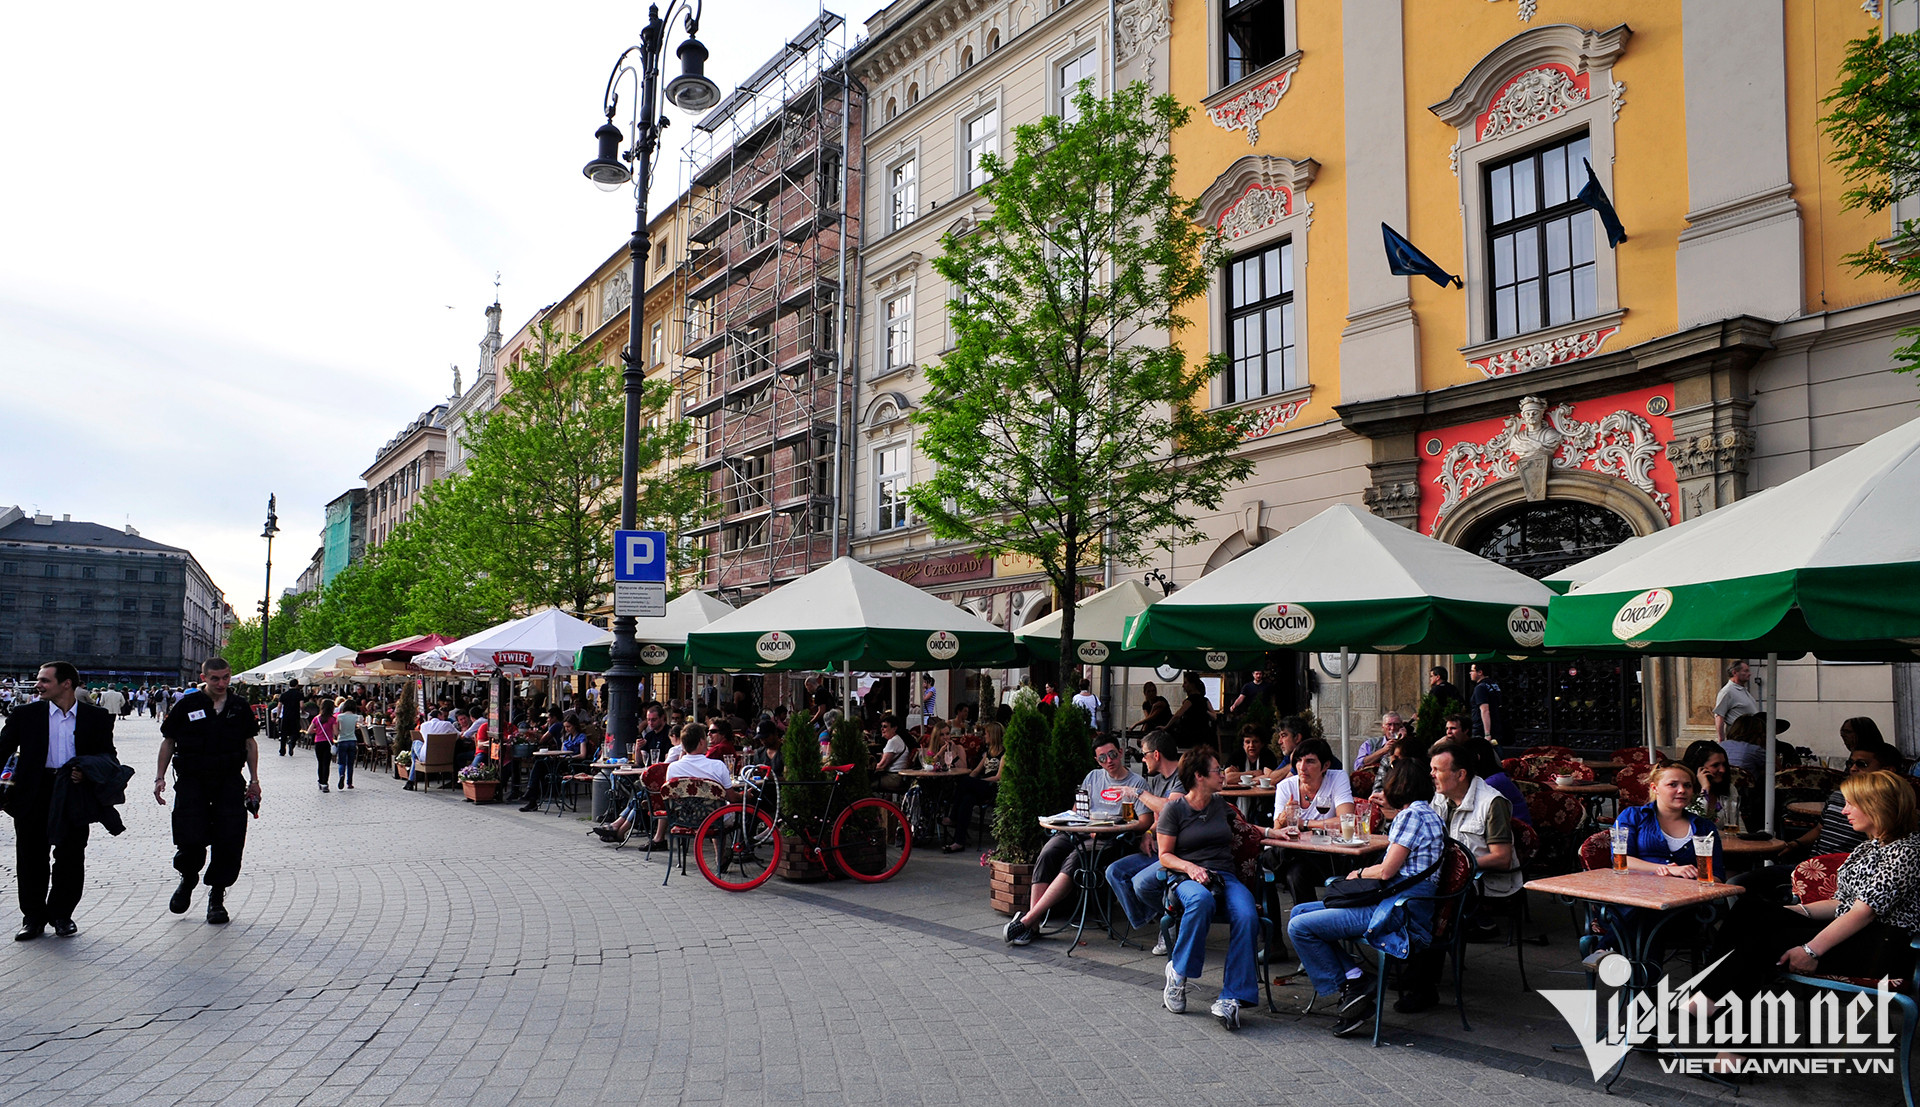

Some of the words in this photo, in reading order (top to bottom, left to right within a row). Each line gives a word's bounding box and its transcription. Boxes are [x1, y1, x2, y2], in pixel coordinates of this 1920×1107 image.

[626, 536, 655, 575] P
[1621, 603, 1665, 624] OKOCIM
[1259, 616, 1308, 631] OKOCIM
[1511, 620, 1545, 634] OKOCIM
[760, 641, 791, 652] OKOCIM
[930, 640, 956, 651] OKOCIM
[1080, 648, 1106, 656] OKOCIM
